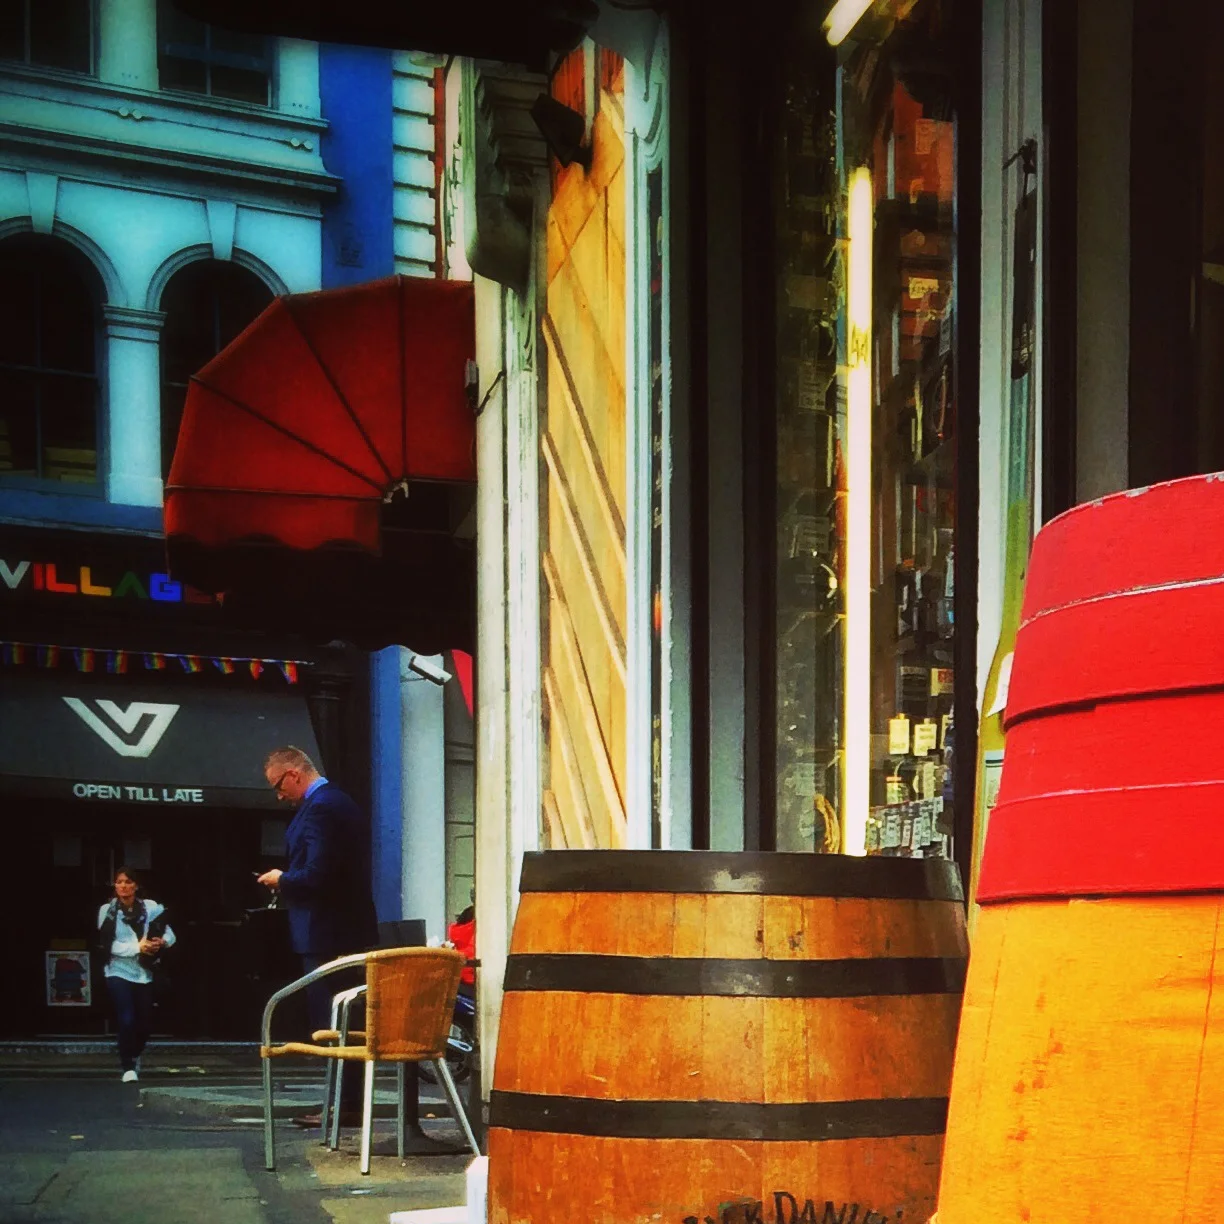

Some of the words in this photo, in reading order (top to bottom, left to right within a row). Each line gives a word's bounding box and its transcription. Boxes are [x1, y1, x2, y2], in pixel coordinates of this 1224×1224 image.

[73, 783, 121, 800] OPEN
[125, 786, 159, 801] TILL
[163, 788, 205, 803] LATE
